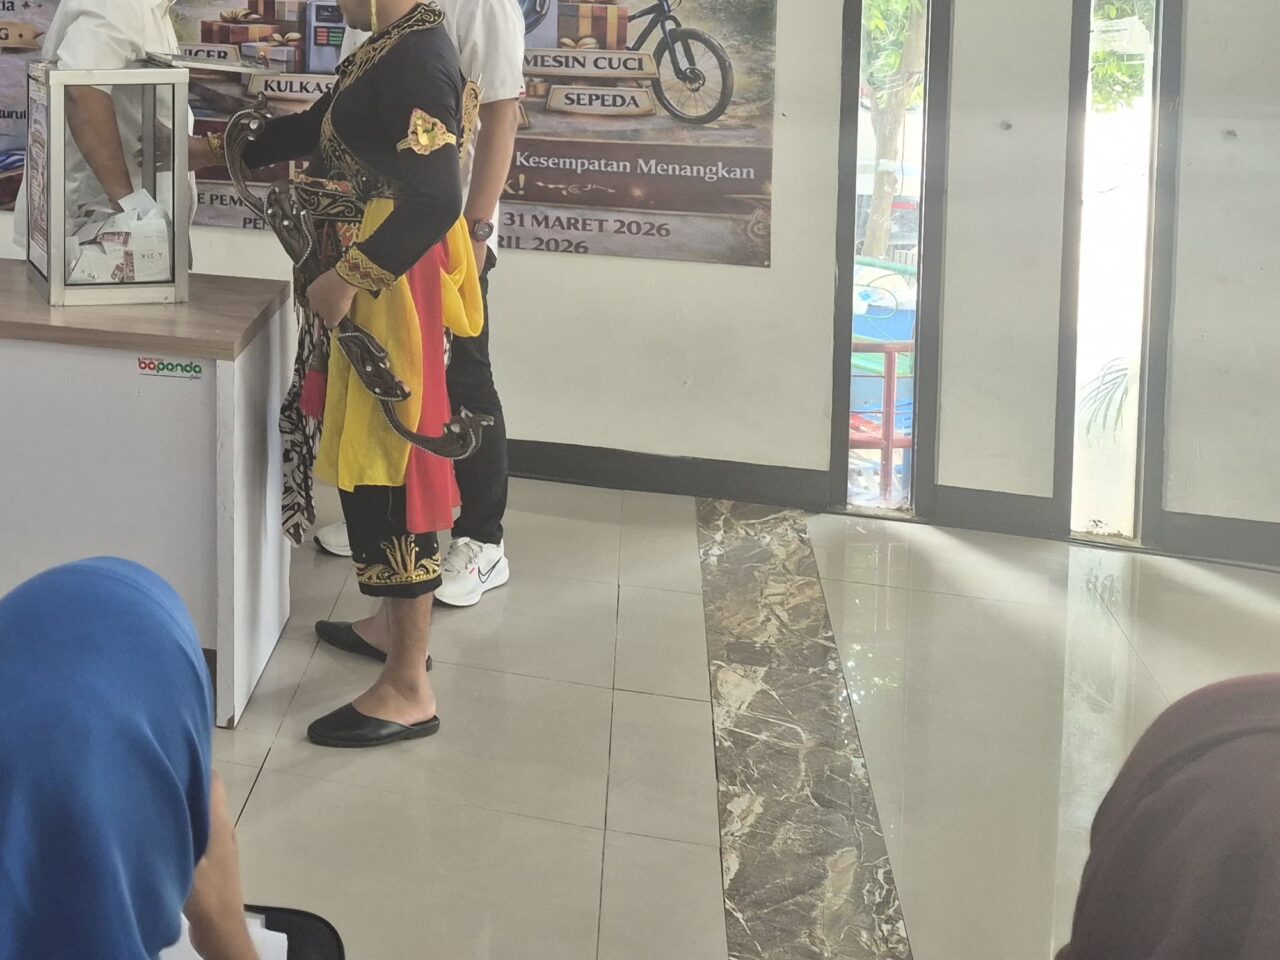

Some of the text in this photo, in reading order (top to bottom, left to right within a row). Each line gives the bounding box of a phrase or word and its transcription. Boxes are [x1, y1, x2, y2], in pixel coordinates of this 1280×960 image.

[523, 54, 645, 71] MESIN CUCI
[563, 92, 640, 108] SEPEDA
[514, 151, 756, 182] Kesempatan Menangkan
[503, 211, 671, 238] 31 MARET 2026
[532, 236, 590, 255] 2026
[137, 357, 203, 374] bapenda
